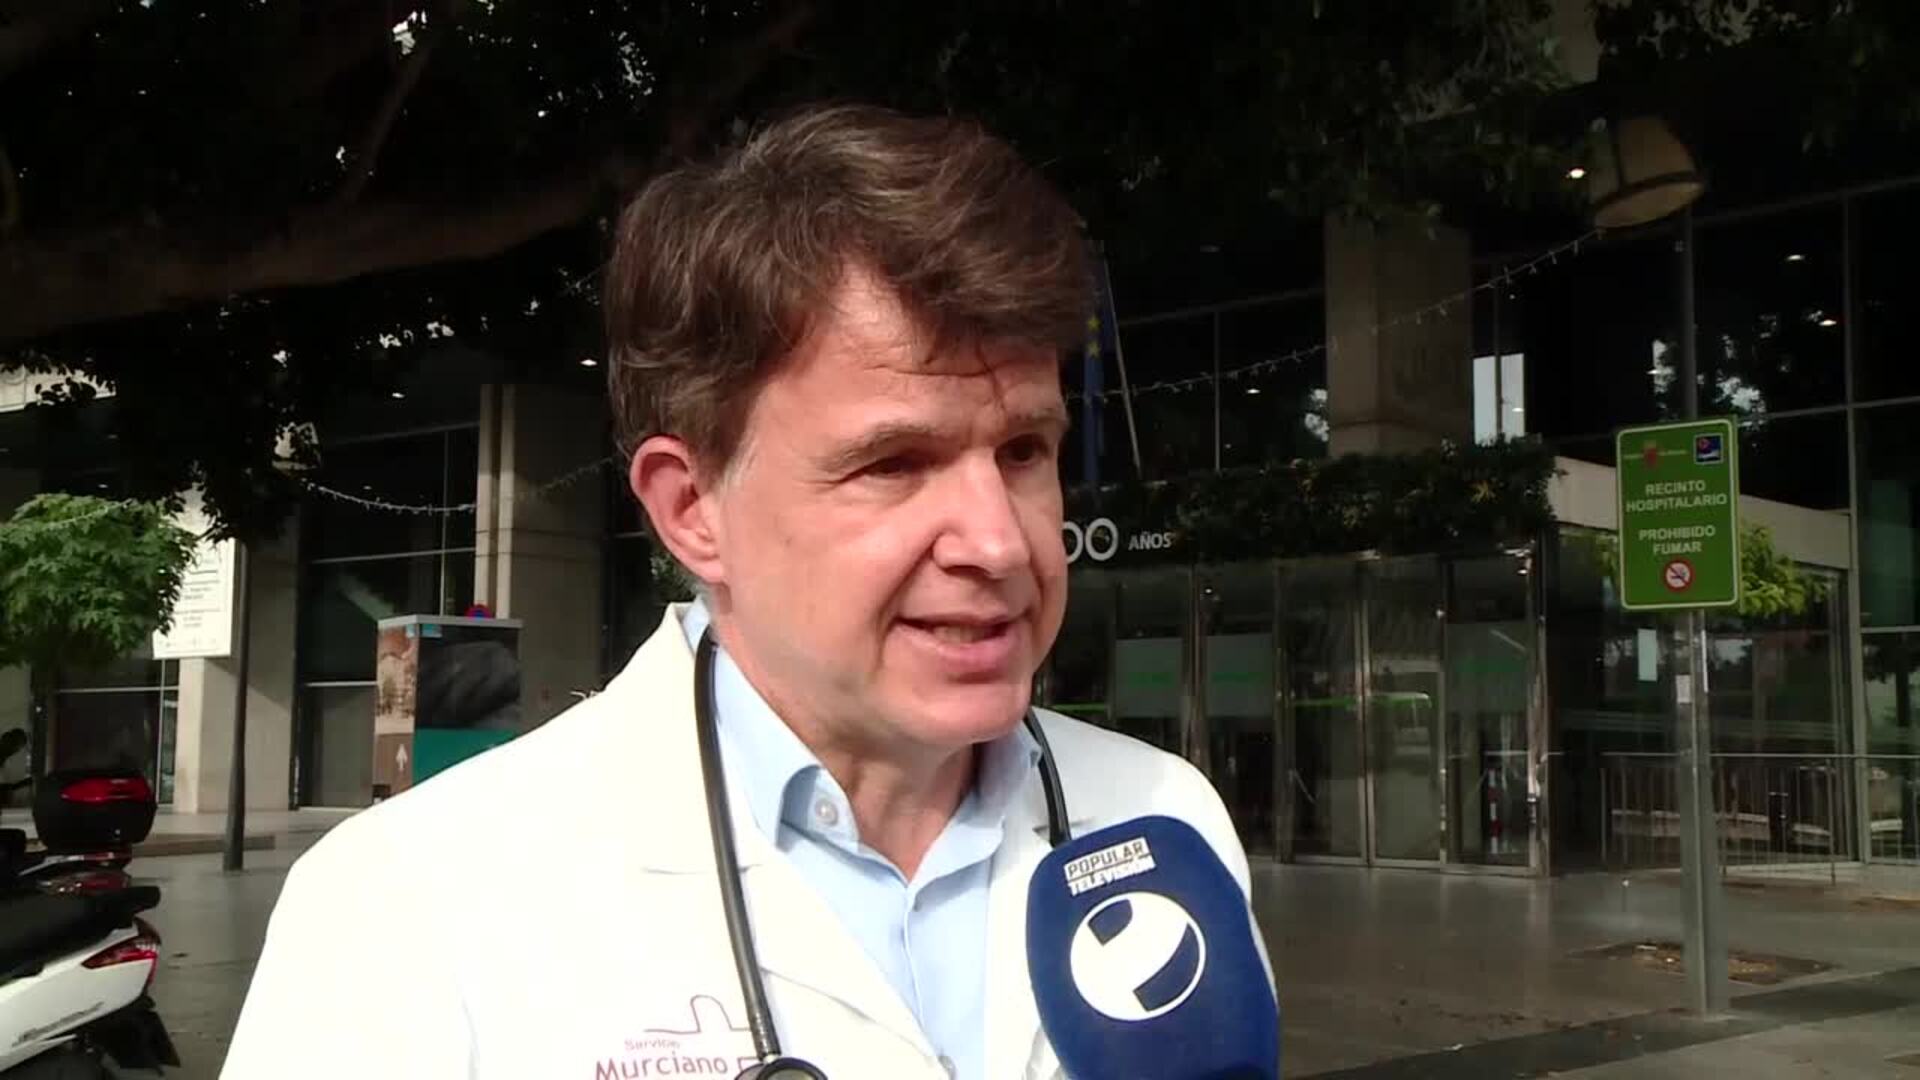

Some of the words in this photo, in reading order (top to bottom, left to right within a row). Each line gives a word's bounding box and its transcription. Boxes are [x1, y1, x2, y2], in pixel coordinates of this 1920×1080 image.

[1645, 480, 1706, 496] RECINTO
[1626, 493, 1728, 512] HOSPITALARIO
[1128, 531, 1173, 551] AÑOS
[1639, 525, 1716, 541] PROHIBIDO
[1653, 542, 1702, 555] FUMAR
[1067, 840, 1145, 878] POPULAR
[595, 1050, 729, 1080] Murciano
